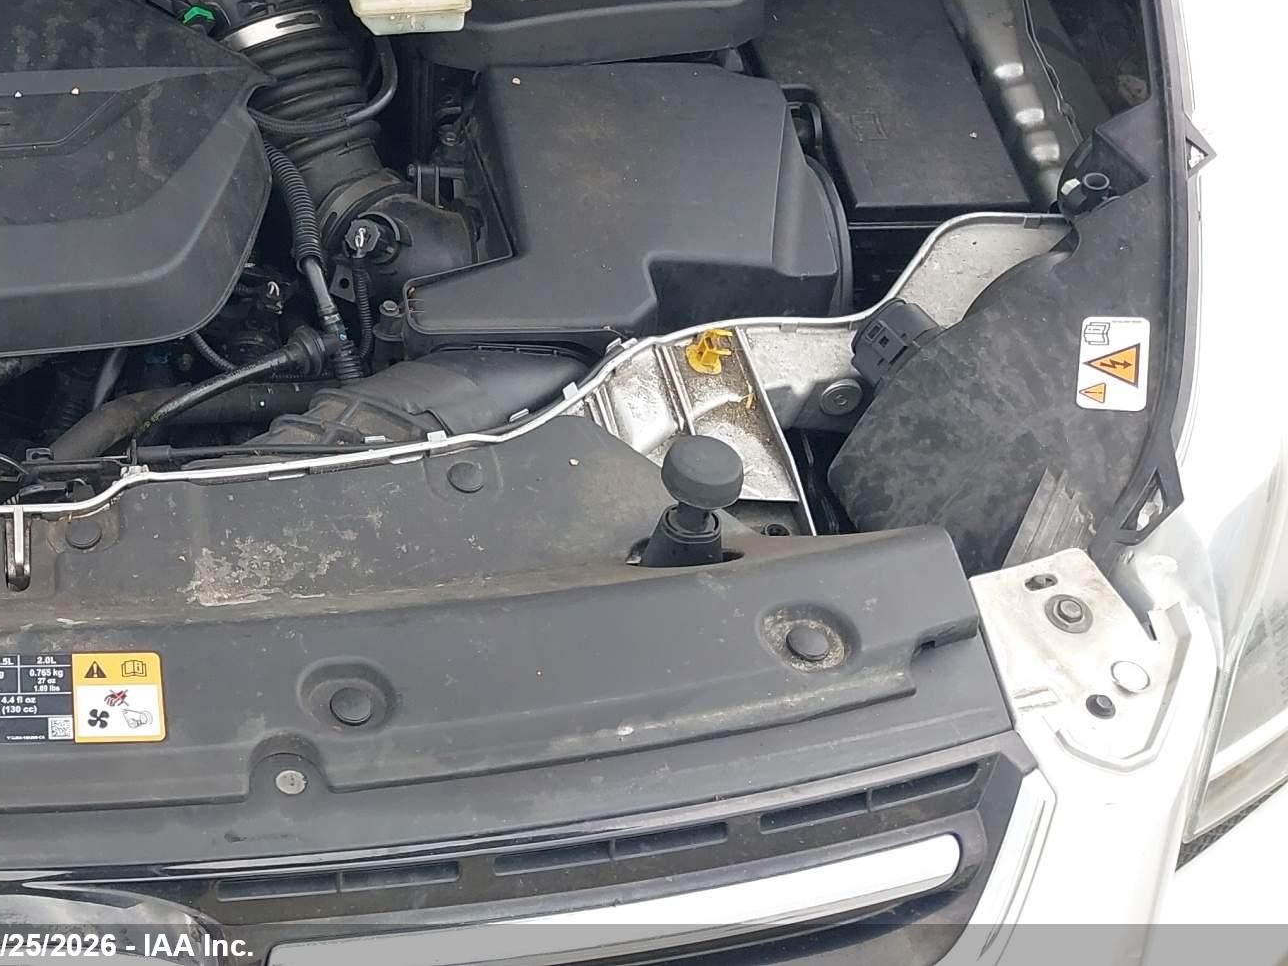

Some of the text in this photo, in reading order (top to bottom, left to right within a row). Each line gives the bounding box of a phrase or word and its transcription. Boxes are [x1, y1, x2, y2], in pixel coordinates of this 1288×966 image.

[36, 656, 57, 664] 2.0L
[52, 668, 64, 678] kg
[1, 696, 15, 704] 4.4
[17, 696, 23, 704] fl
[1, 705, 38, 715] (130 cc)
